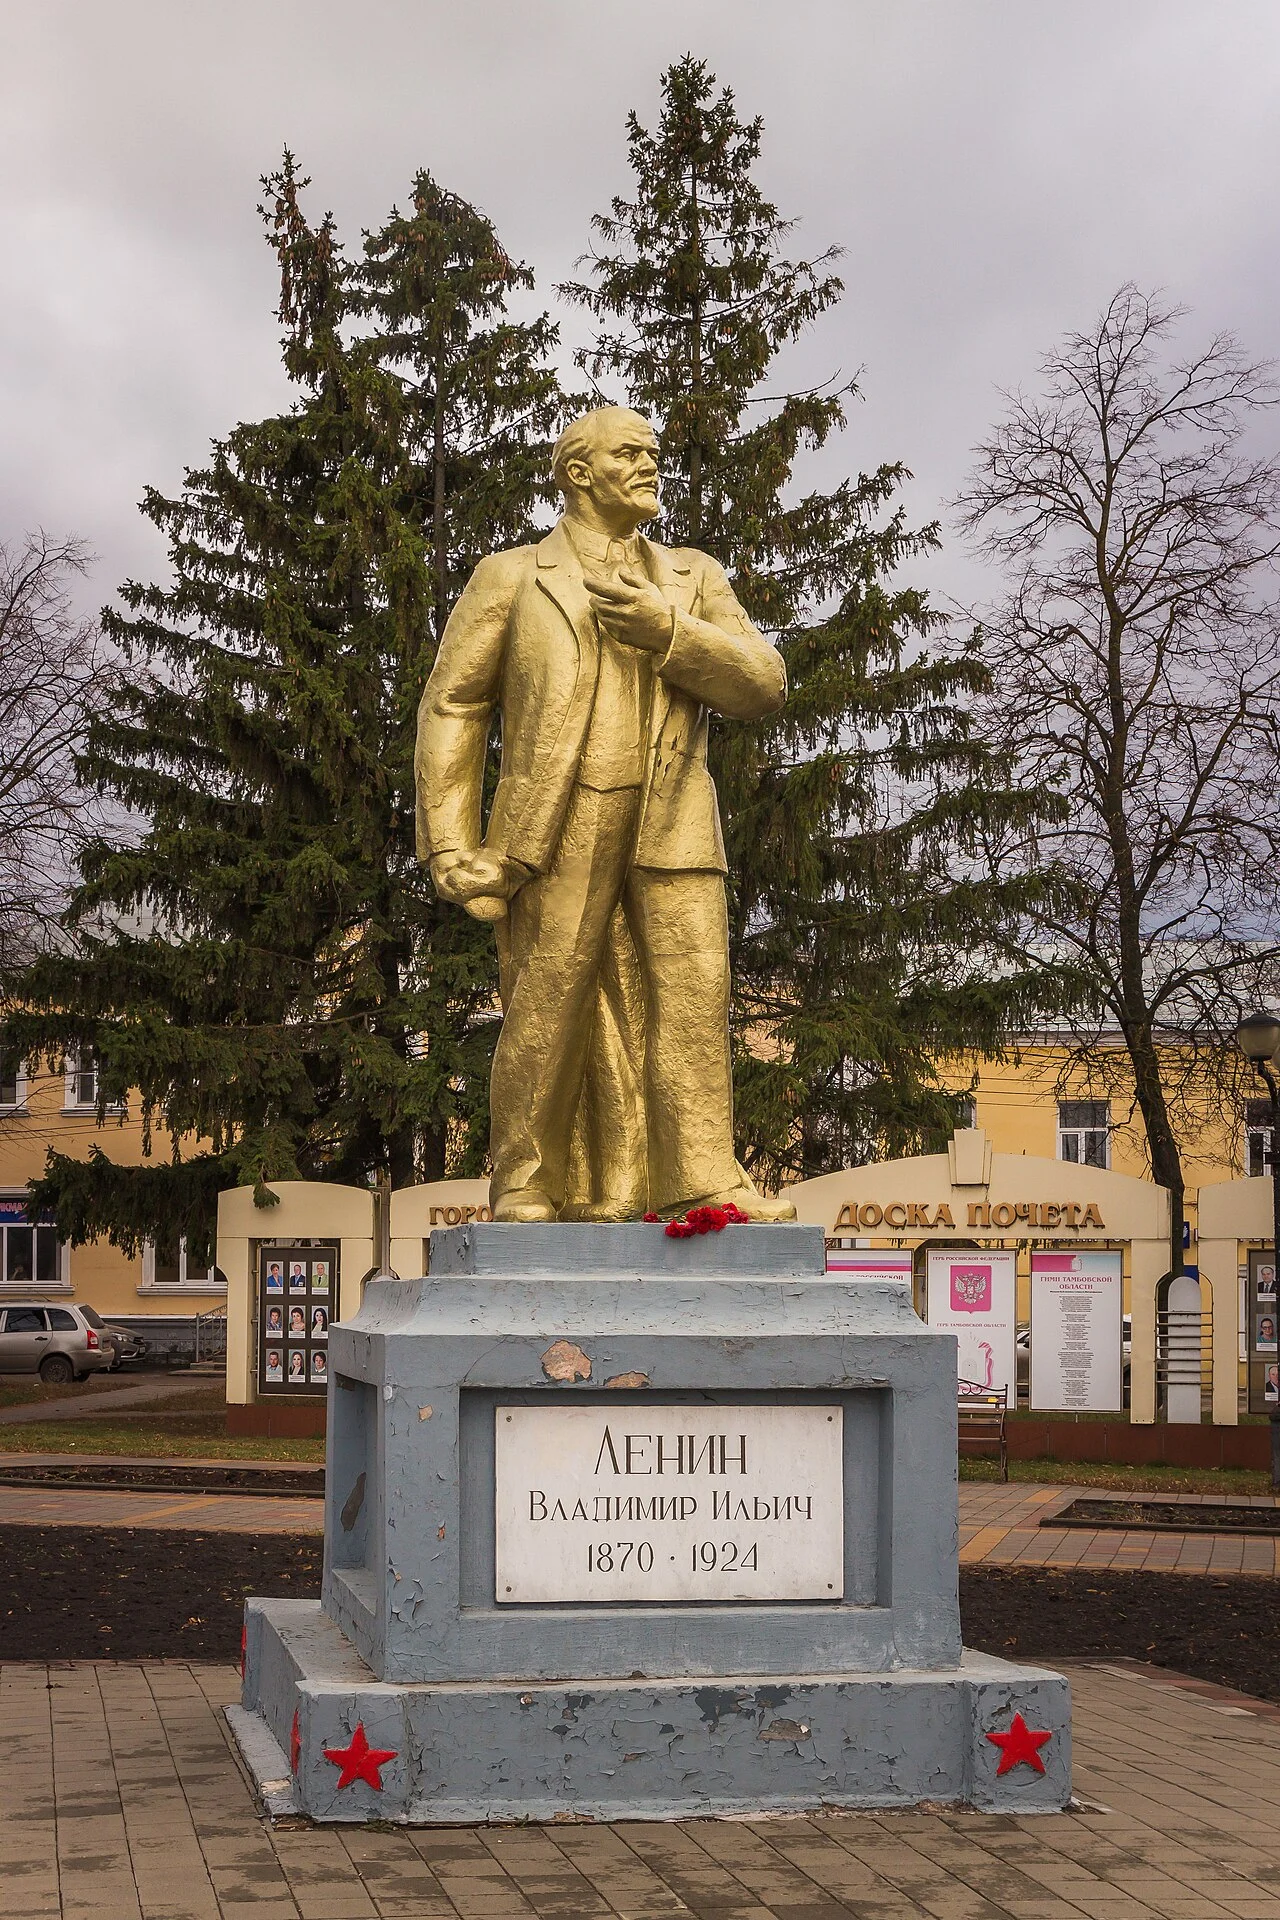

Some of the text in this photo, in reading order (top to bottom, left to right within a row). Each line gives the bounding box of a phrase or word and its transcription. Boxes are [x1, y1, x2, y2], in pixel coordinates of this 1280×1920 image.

[834, 1202, 1106, 1233] ДОСКА ПОЧЕТА
[594, 1424, 748, 1475] ЛЕНИН
[587, 1541, 654, 1573] 1870
[691, 1541, 759, 1573] 1924
